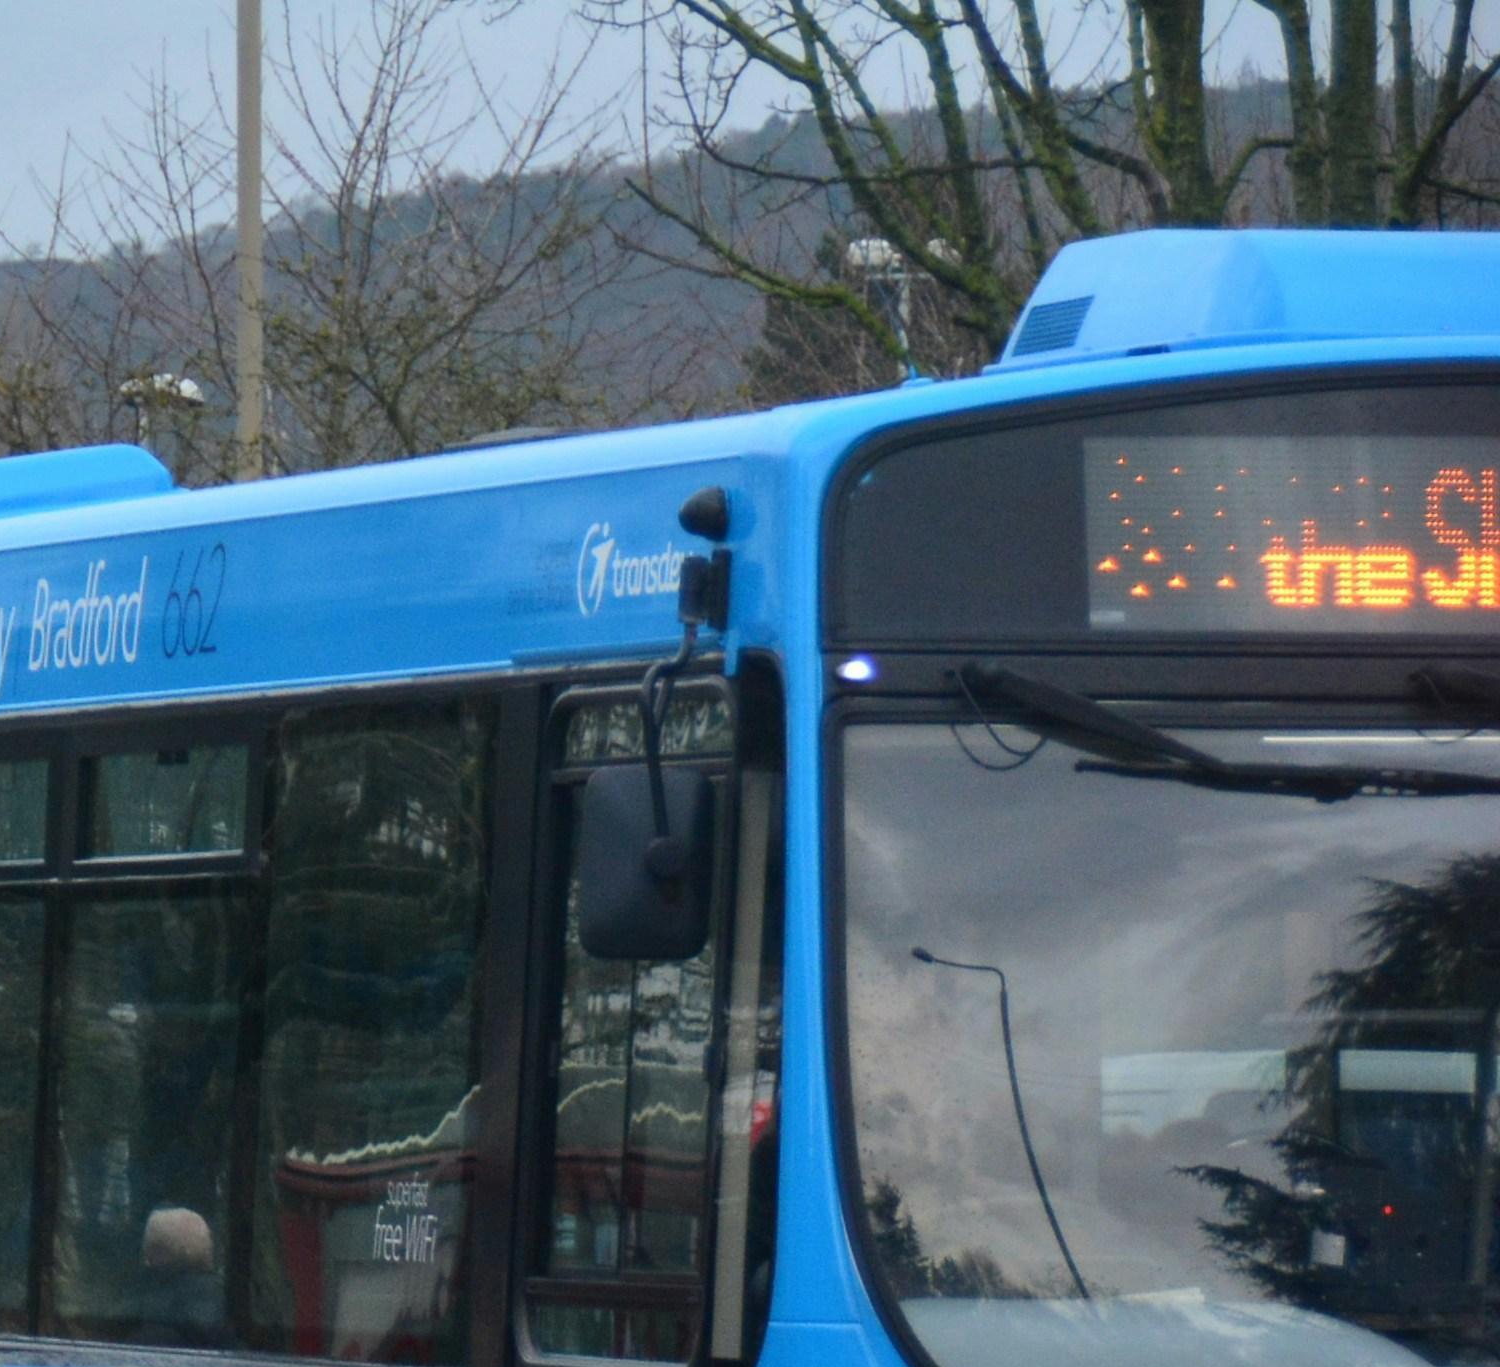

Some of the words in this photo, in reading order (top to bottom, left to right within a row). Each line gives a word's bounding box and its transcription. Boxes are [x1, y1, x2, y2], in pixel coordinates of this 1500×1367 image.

[613, 541, 694, 597] transde
[1260, 519, 1414, 607] the
[29, 555, 148, 671] Bradford
[161, 543, 226, 659] 662
[386, 1171, 428, 1213] superfast
[372, 1204, 402, 1261] free
